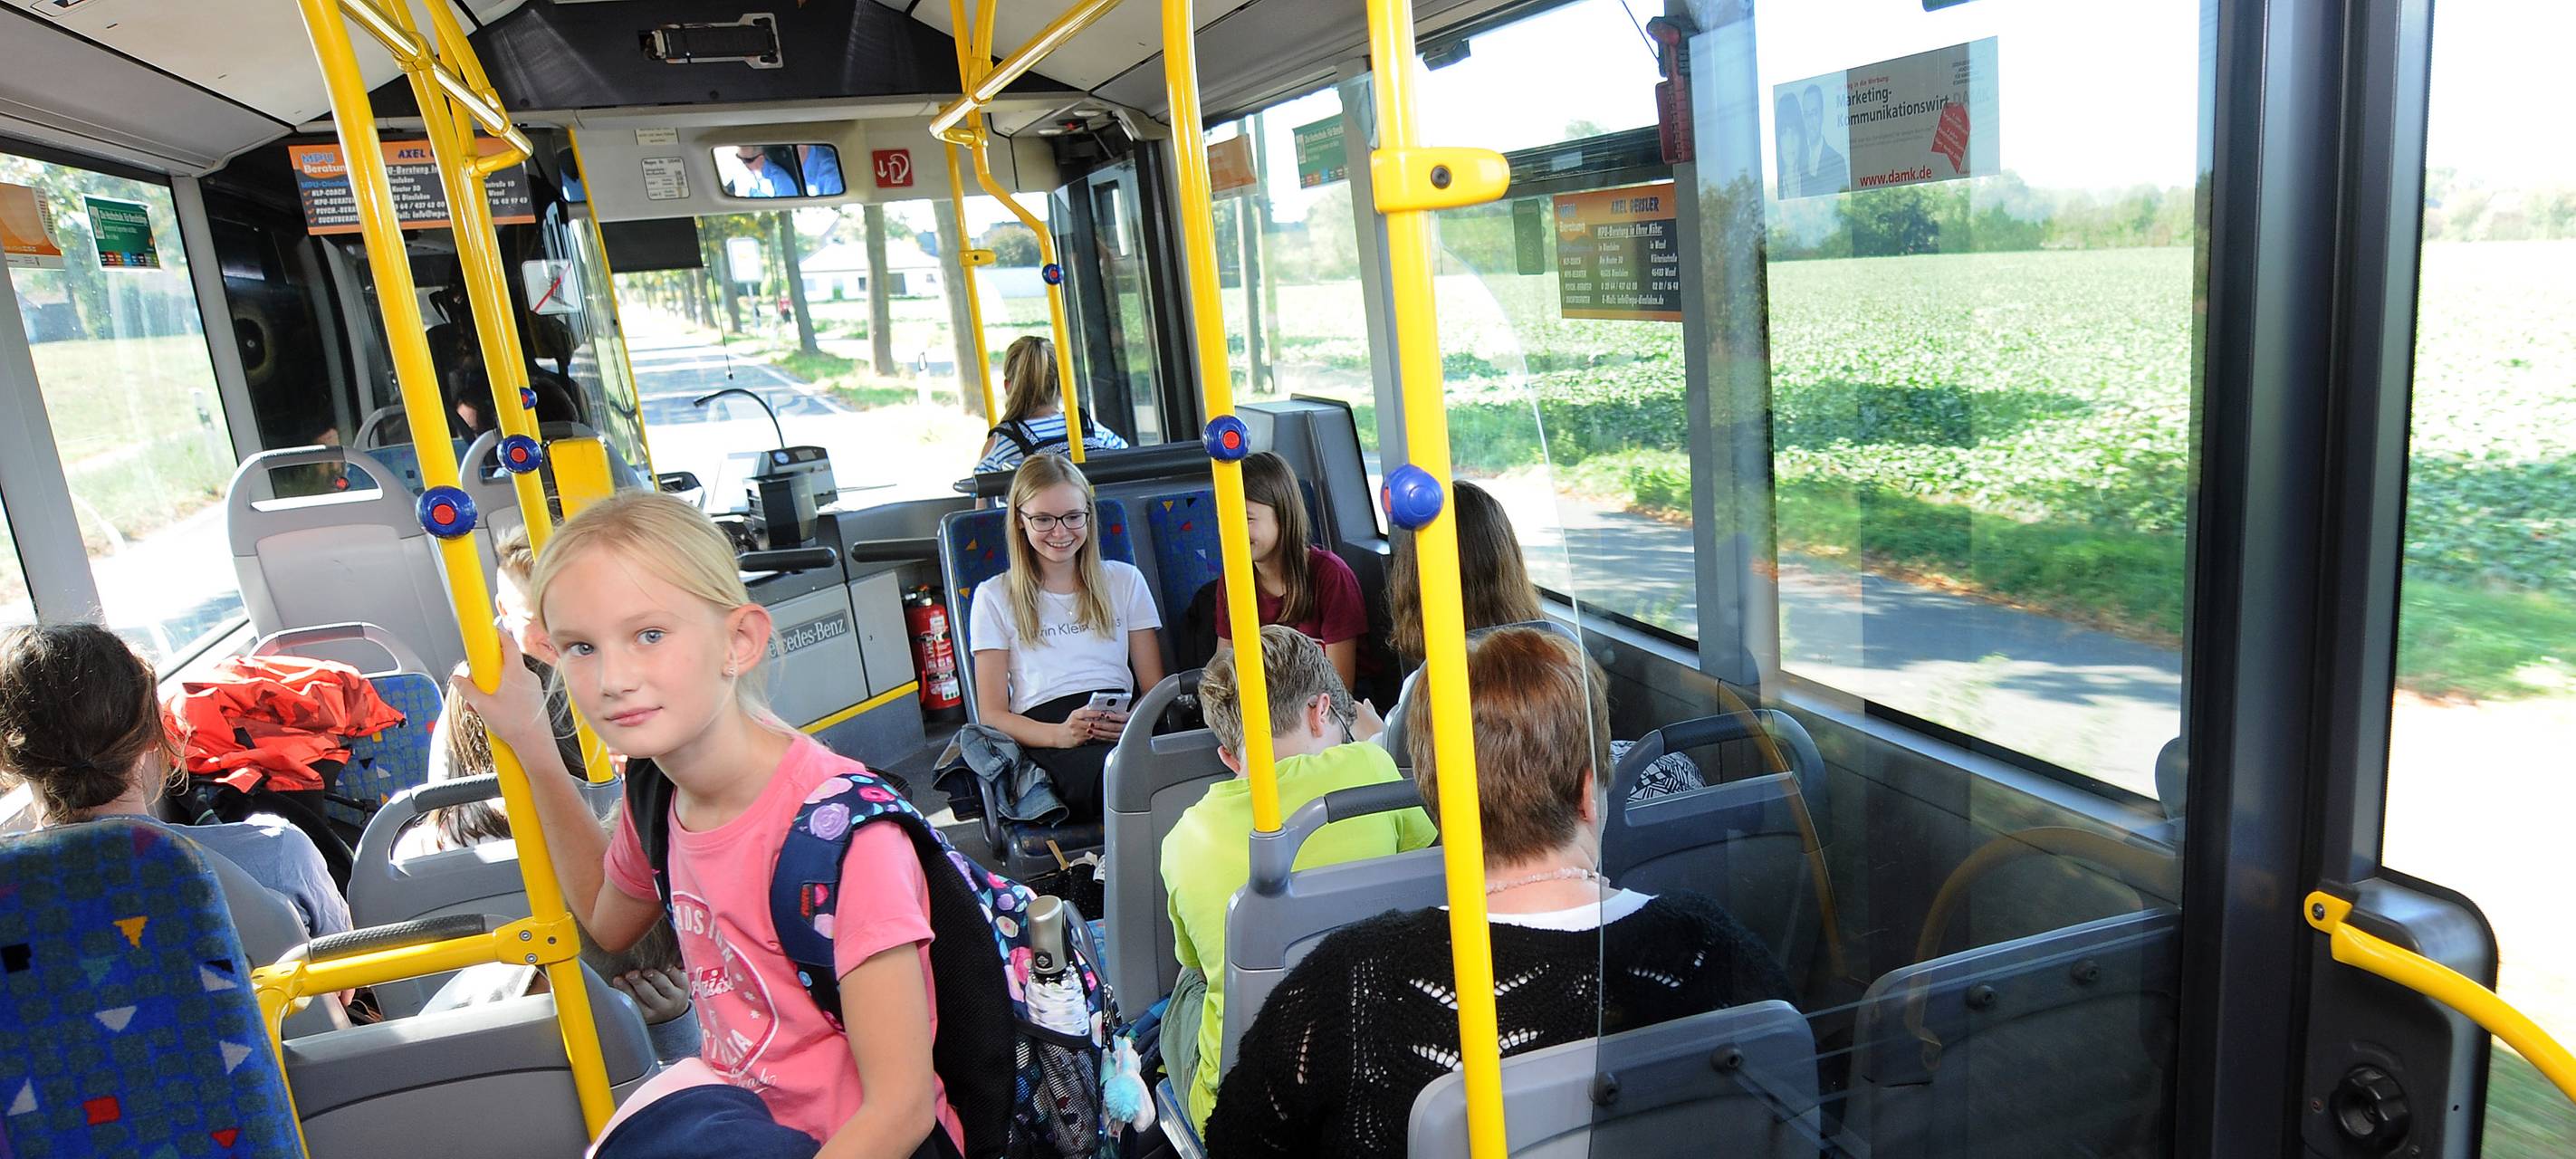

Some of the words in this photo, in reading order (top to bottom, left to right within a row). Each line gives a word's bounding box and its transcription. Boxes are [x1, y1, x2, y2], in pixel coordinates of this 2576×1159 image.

[1836, 87, 1892, 108] Marketing-
[1837, 94, 1949, 127] Kommunikationswirt
[301, 152, 334, 163] MPU
[398, 148, 426, 158] AXEL
[304, 164, 346, 173] Beratun
[388, 166, 428, 175] U-Beratung
[1860, 165, 1932, 187] www.damk.de
[313, 196, 355, 206] MPU-BERATE
